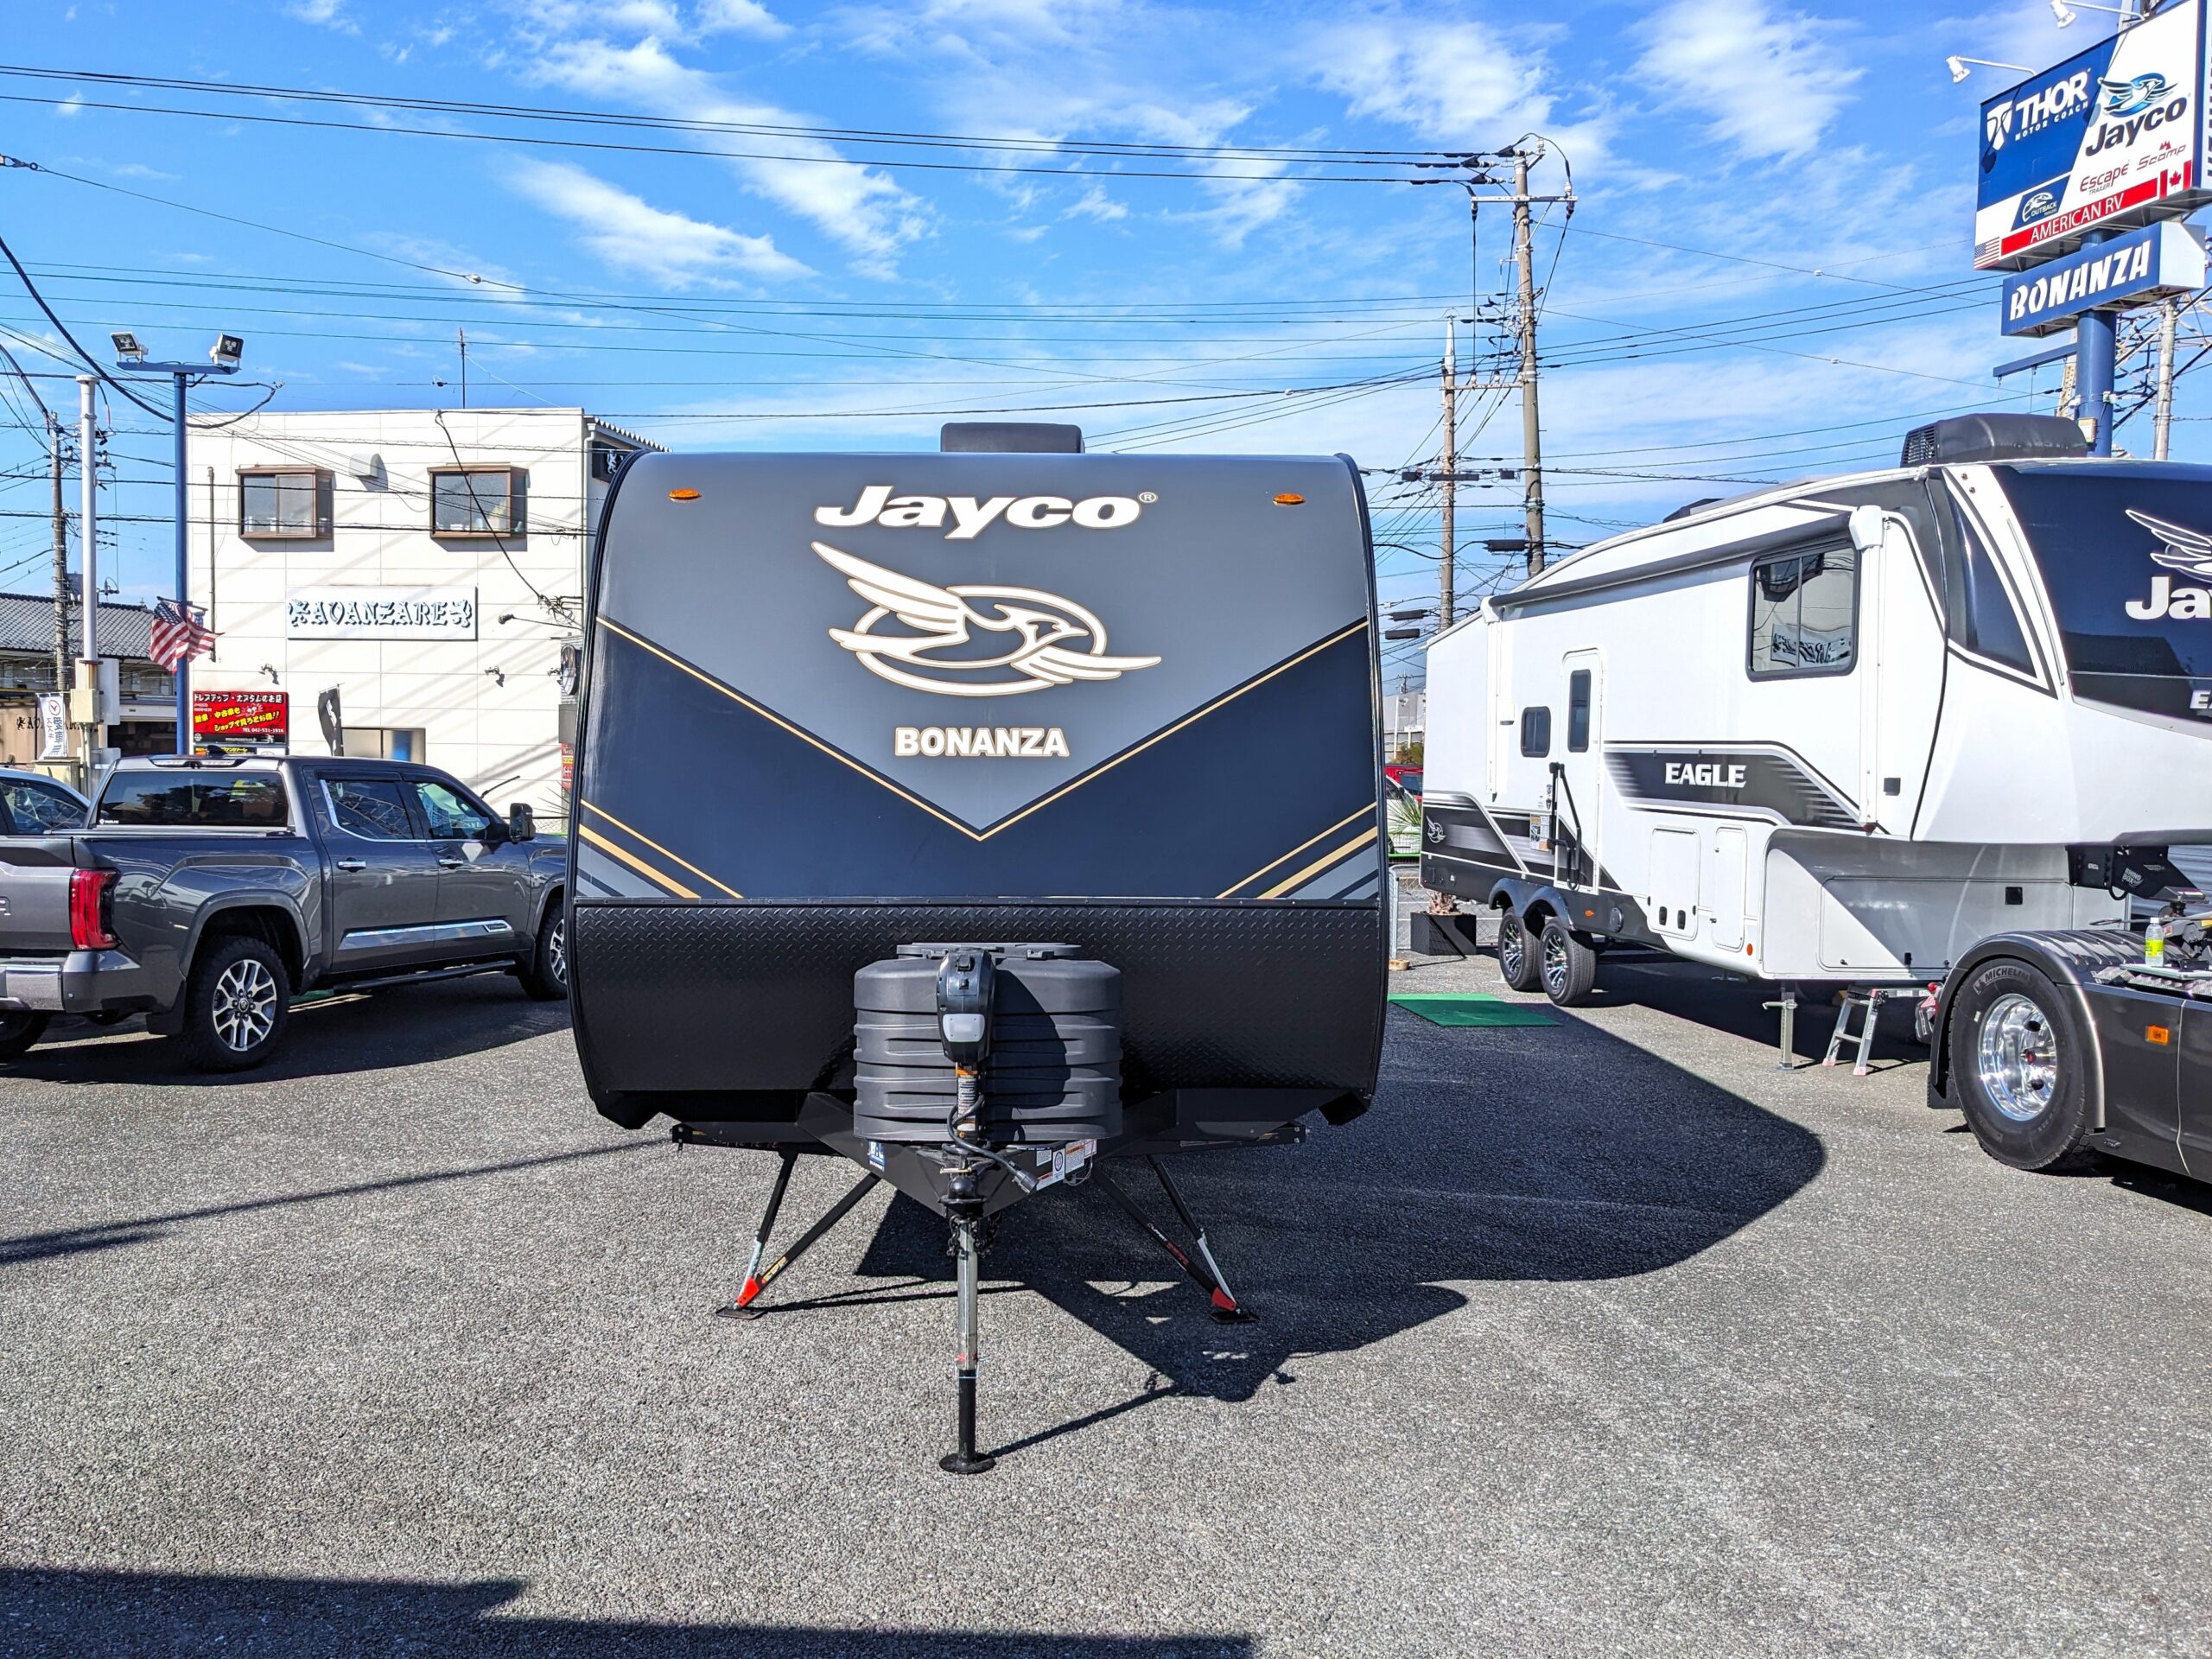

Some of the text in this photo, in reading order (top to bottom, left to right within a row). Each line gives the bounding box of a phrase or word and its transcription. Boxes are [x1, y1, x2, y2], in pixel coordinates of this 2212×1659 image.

[2015, 72, 2088, 130] THOR
[2015, 101, 2088, 141] MOTOR COACH
[2085, 97, 2187, 156] Jayco
[2080, 162, 2129, 192] Escape
[2031, 200, 2057, 217] OUTBACK
[2031, 192, 2125, 244] AMERICAN RV
[2010, 239, 2152, 321] BONANZA
[815, 486, 1141, 539] Jayco
[894, 726, 1071, 757] BONANZA
[1664, 762, 1747, 788] EAGLE
[2125, 867, 2142, 881] RHINO
[1984, 967, 2030, 982] MICHELIN
